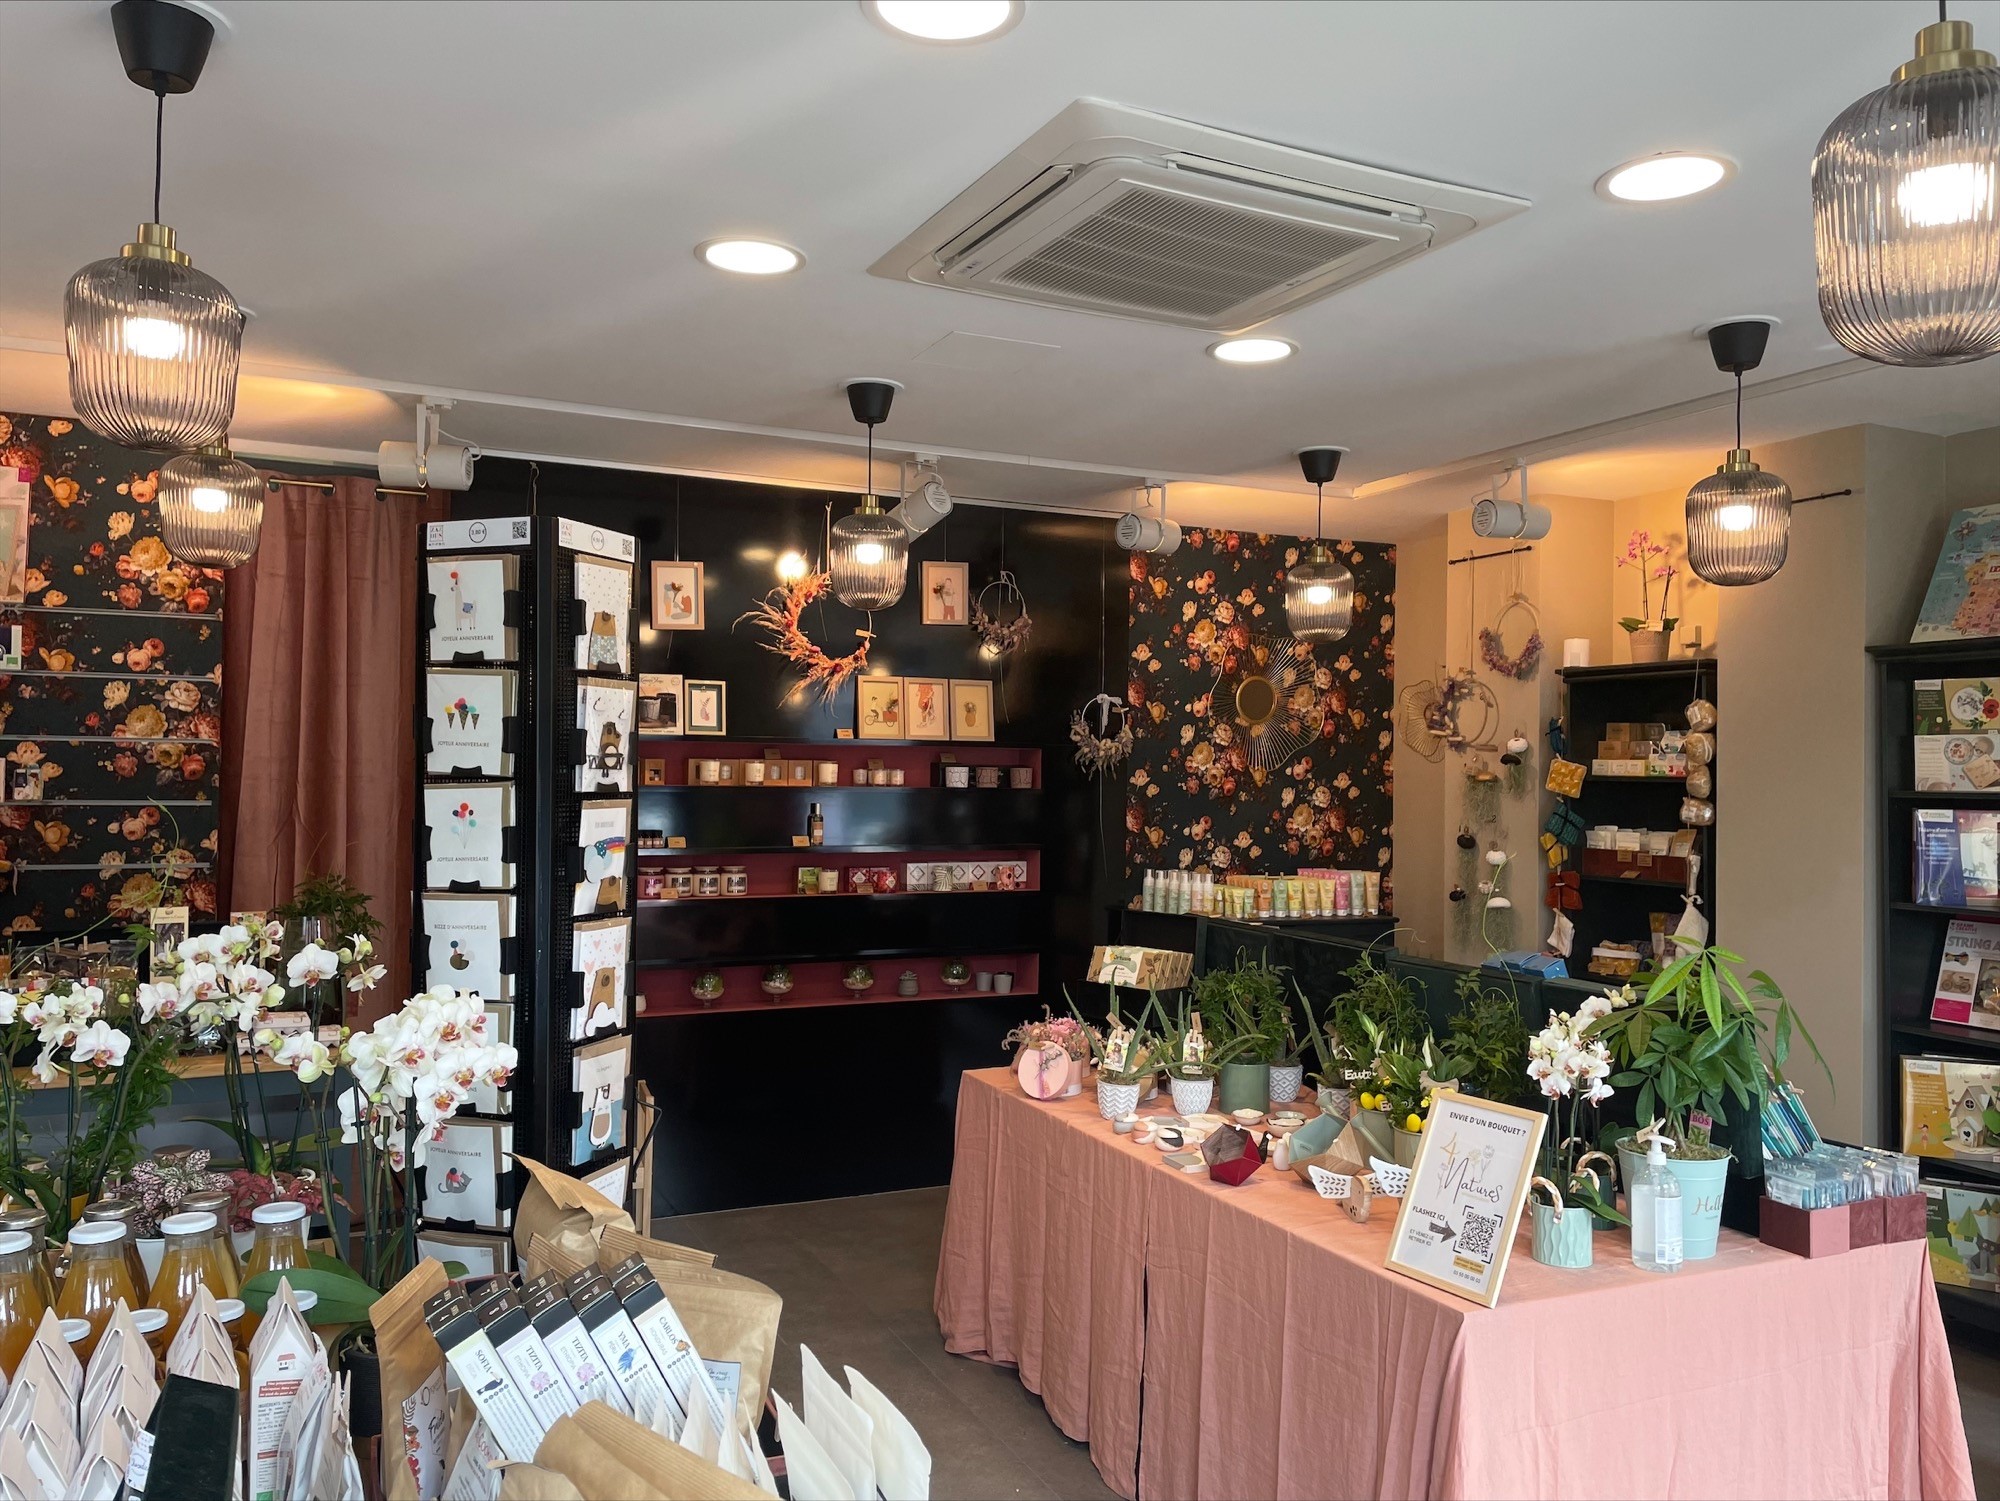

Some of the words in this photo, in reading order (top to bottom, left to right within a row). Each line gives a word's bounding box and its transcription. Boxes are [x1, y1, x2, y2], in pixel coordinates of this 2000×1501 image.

[1946, 935, 1992, 950] STRING
[1449, 1112, 1468, 1122] ENVIE
[1469, 1116, 1487, 1127] D'UN
[1487, 1121, 1521, 1136] BOUQUET
[1692, 1115, 1709, 1126] BOS
[447, 1149, 482, 1158] ANNIVERSAIRE
[1412, 1205, 1437, 1219] FLASHEZ
[618, 1331, 631, 1350] YMA
[660, 1316, 679, 1345] CARLOS
[525, 1345, 544, 1371] TIZITA
[571, 1336, 589, 1362] TIZITA
[474, 1349, 493, 1374] SOFIA
